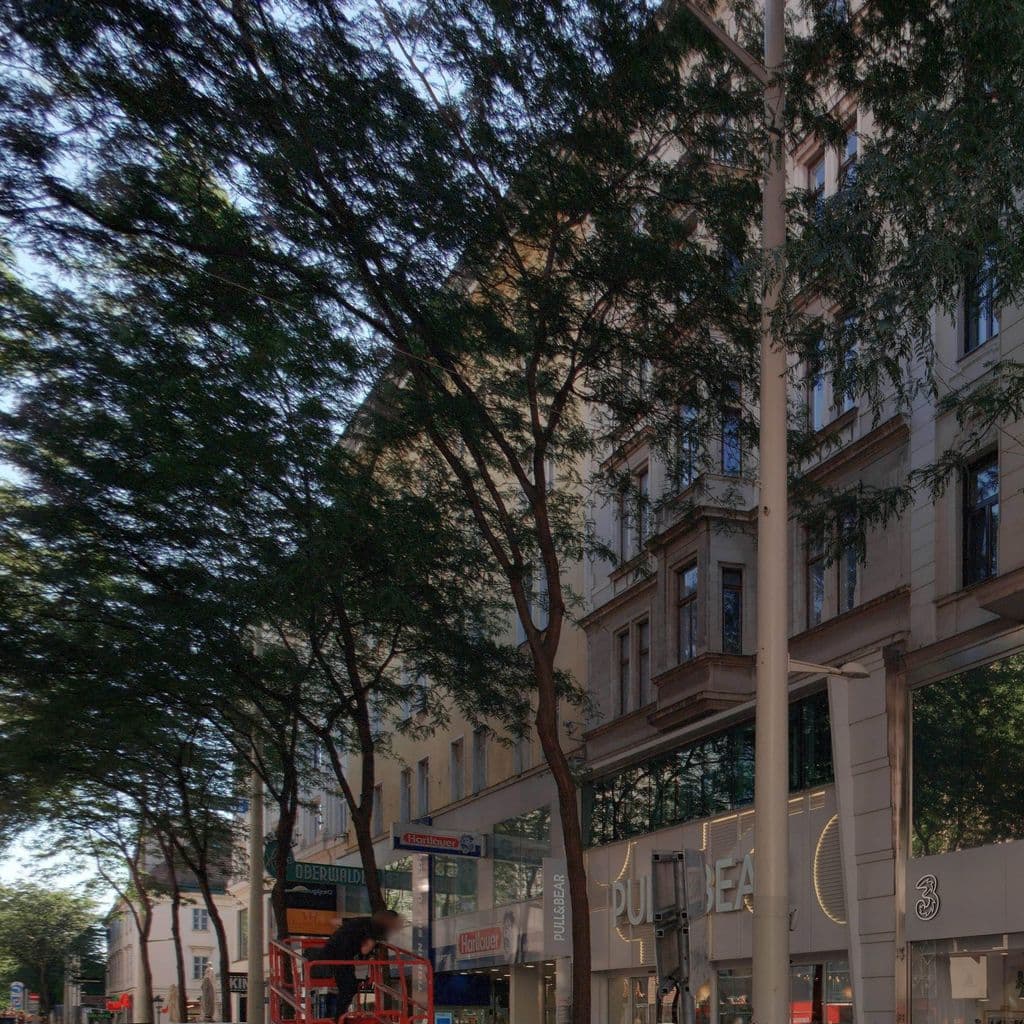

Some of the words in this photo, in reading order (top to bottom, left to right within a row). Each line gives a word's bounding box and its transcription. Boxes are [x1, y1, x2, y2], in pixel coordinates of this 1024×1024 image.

[407, 832, 457, 849] Hartlauer
[296, 863, 367, 885] OBERWALD
[553, 873, 566, 942] PULL&BEAR
